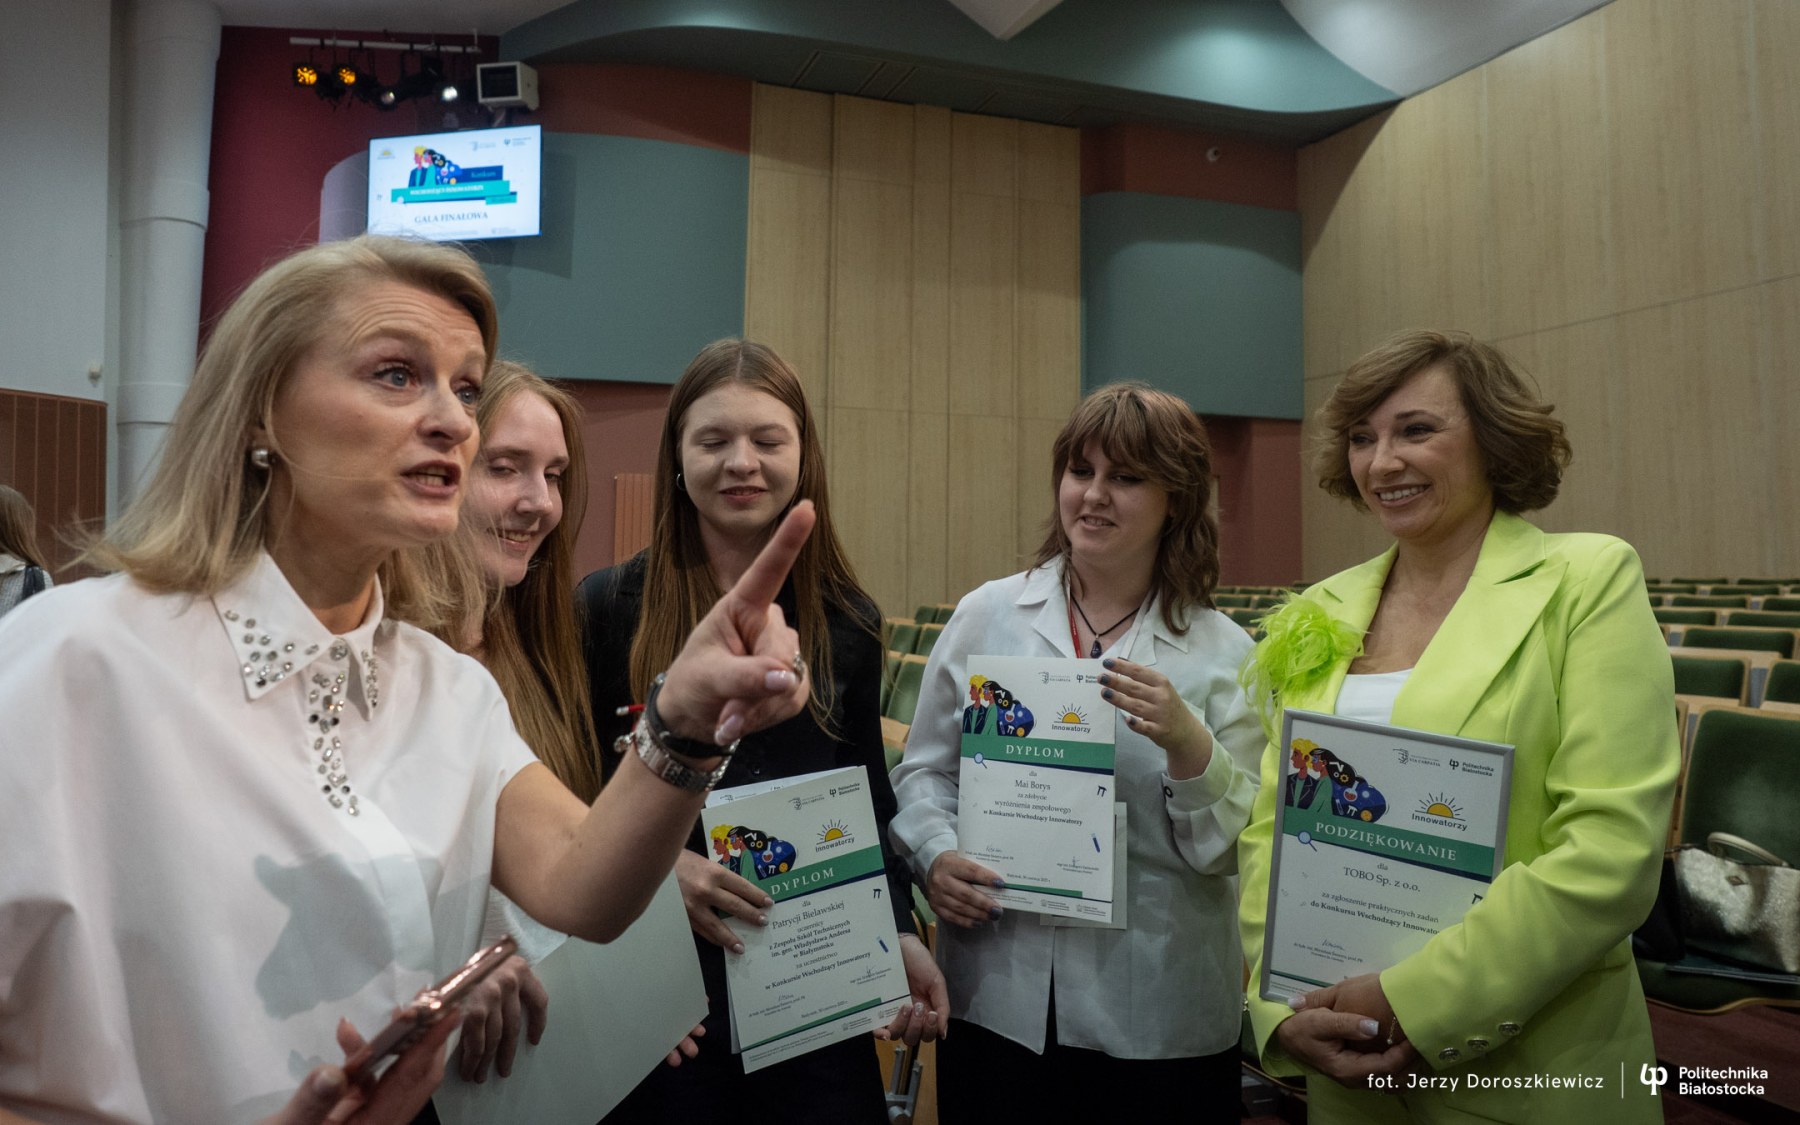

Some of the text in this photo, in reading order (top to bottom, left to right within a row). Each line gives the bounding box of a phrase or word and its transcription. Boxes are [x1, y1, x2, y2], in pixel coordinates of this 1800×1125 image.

[414, 211, 489, 223] GALA FINAŁOWA
[1051, 724, 1091, 734] Innowatorzy
[1005, 744, 1065, 759] DYPLOM
[1462, 761, 1495, 772] Politechnika
[1014, 779, 1051, 791] Mai Borys
[994, 800, 1031, 810] wyróżnienia
[1024, 793, 1048, 802] zdobycie
[988, 809, 1015, 818] Konkursie
[1015, 812, 1048, 823] Wschodzący
[1049, 816, 1083, 826] Innowatorzy
[1411, 812, 1469, 832] Innowatorzy
[815, 837, 855, 853] Innowatorzy
[1314, 821, 1457, 861] PODZIĘKOWANIE
[1377, 862, 1389, 871] dla
[770, 867, 835, 895] DYPLOM
[1343, 866, 1421, 893] TOBO Sp. z o.o.
[802, 899, 812, 908] dla
[1321, 891, 1439, 924] za zgłoszenie praktycznych zadań
[772, 900, 846, 930] Patrycji Bielawskiej
[1310, 899, 1440, 935] do Konkursu Wschodzący Innowato
[773, 937, 796, 951] Zespołu
[813, 919, 851, 936] Technicznych
[771, 974, 802, 989] Konkursie
[801, 961, 836, 979] Wschodzący
[836, 951, 871, 967] Innowatorzy
